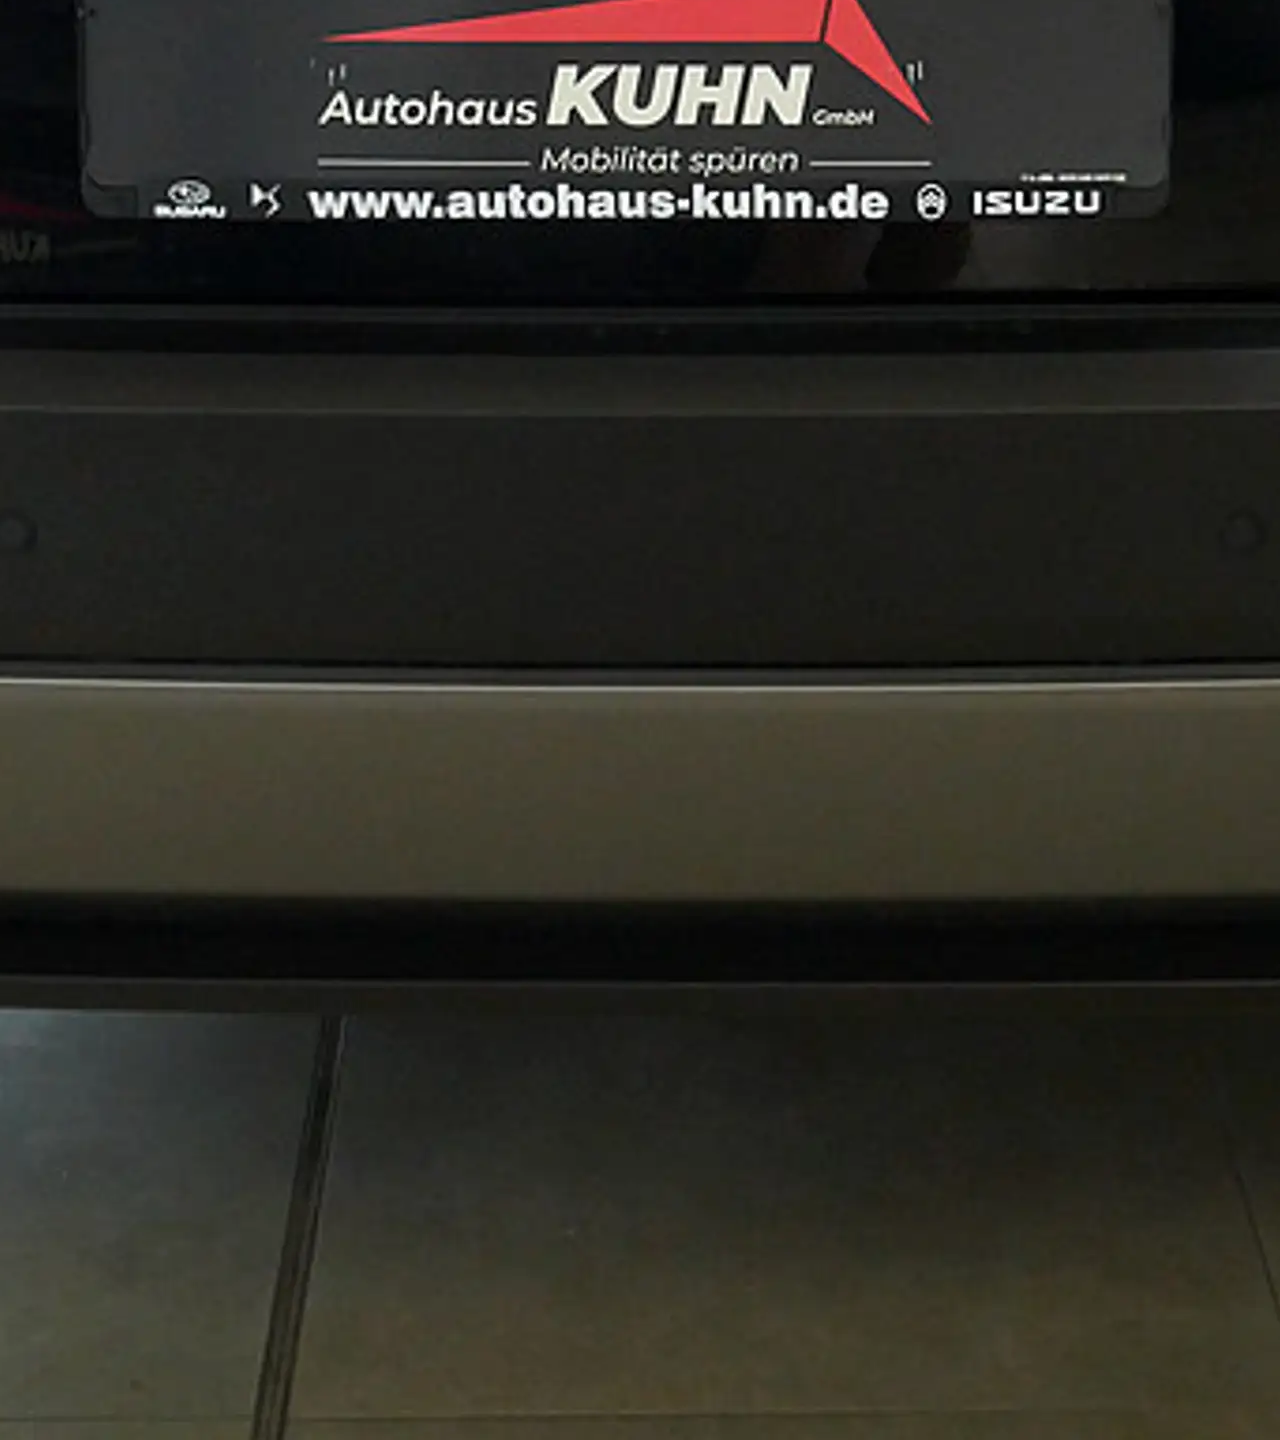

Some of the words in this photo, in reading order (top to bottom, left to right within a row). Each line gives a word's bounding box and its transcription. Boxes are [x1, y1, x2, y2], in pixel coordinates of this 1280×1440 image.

[318, 89, 538, 127] Autohaus
[546, 63, 813, 127] KUHN
[812, 108, 875, 127] GmbH
[540, 145, 682, 175] Mobilität
[687, 146, 800, 178] spüren
[306, 182, 890, 220] www.autohaus-kuhn.de
[972, 190, 1101, 216] ISUZU
